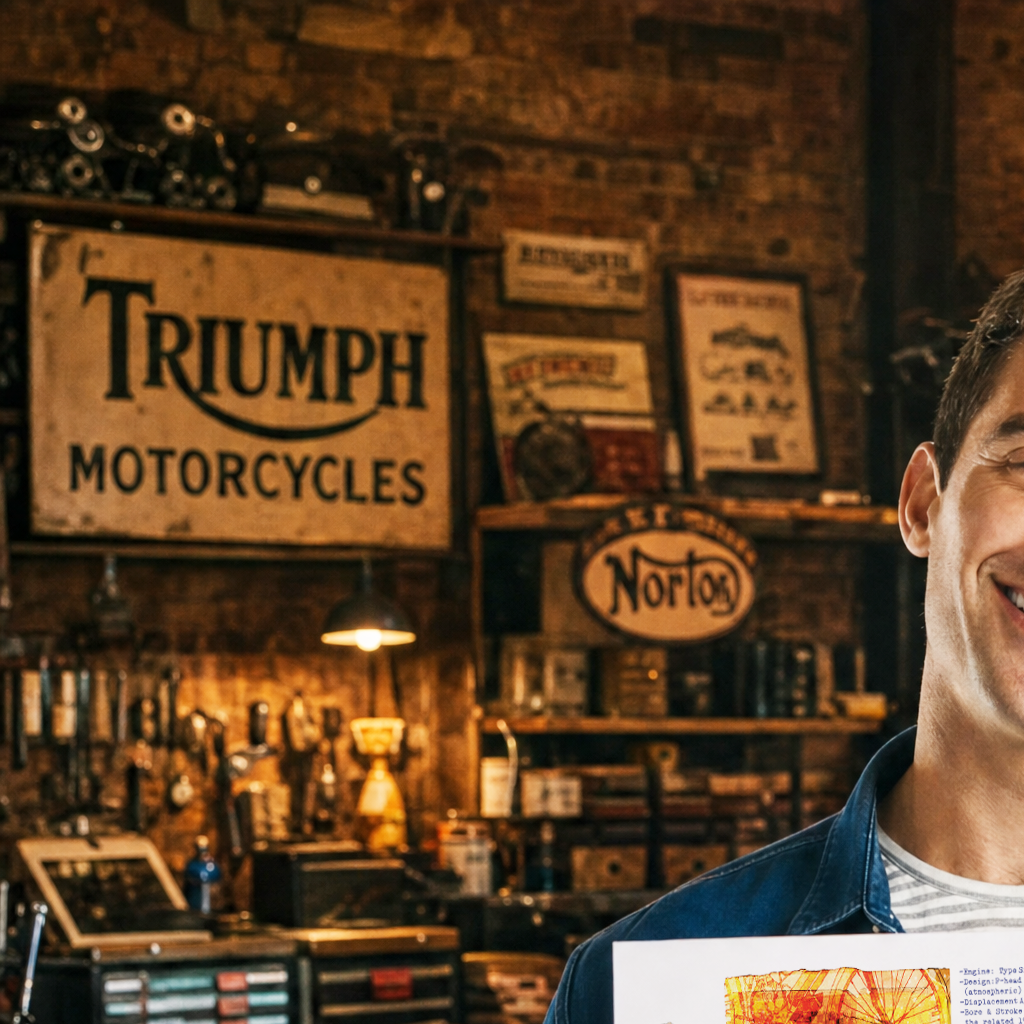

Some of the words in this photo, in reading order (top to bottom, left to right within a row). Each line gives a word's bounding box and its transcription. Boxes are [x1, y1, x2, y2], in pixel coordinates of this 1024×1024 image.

[82, 277, 428, 441] TRIUMPH
[69, 444, 427, 506] MOTORCYCLES
[959, 968, 994, 976] -Engine:
[964, 986, 1022, 996] (atmospheric)
[960, 1008, 982, 1016] -Bore
